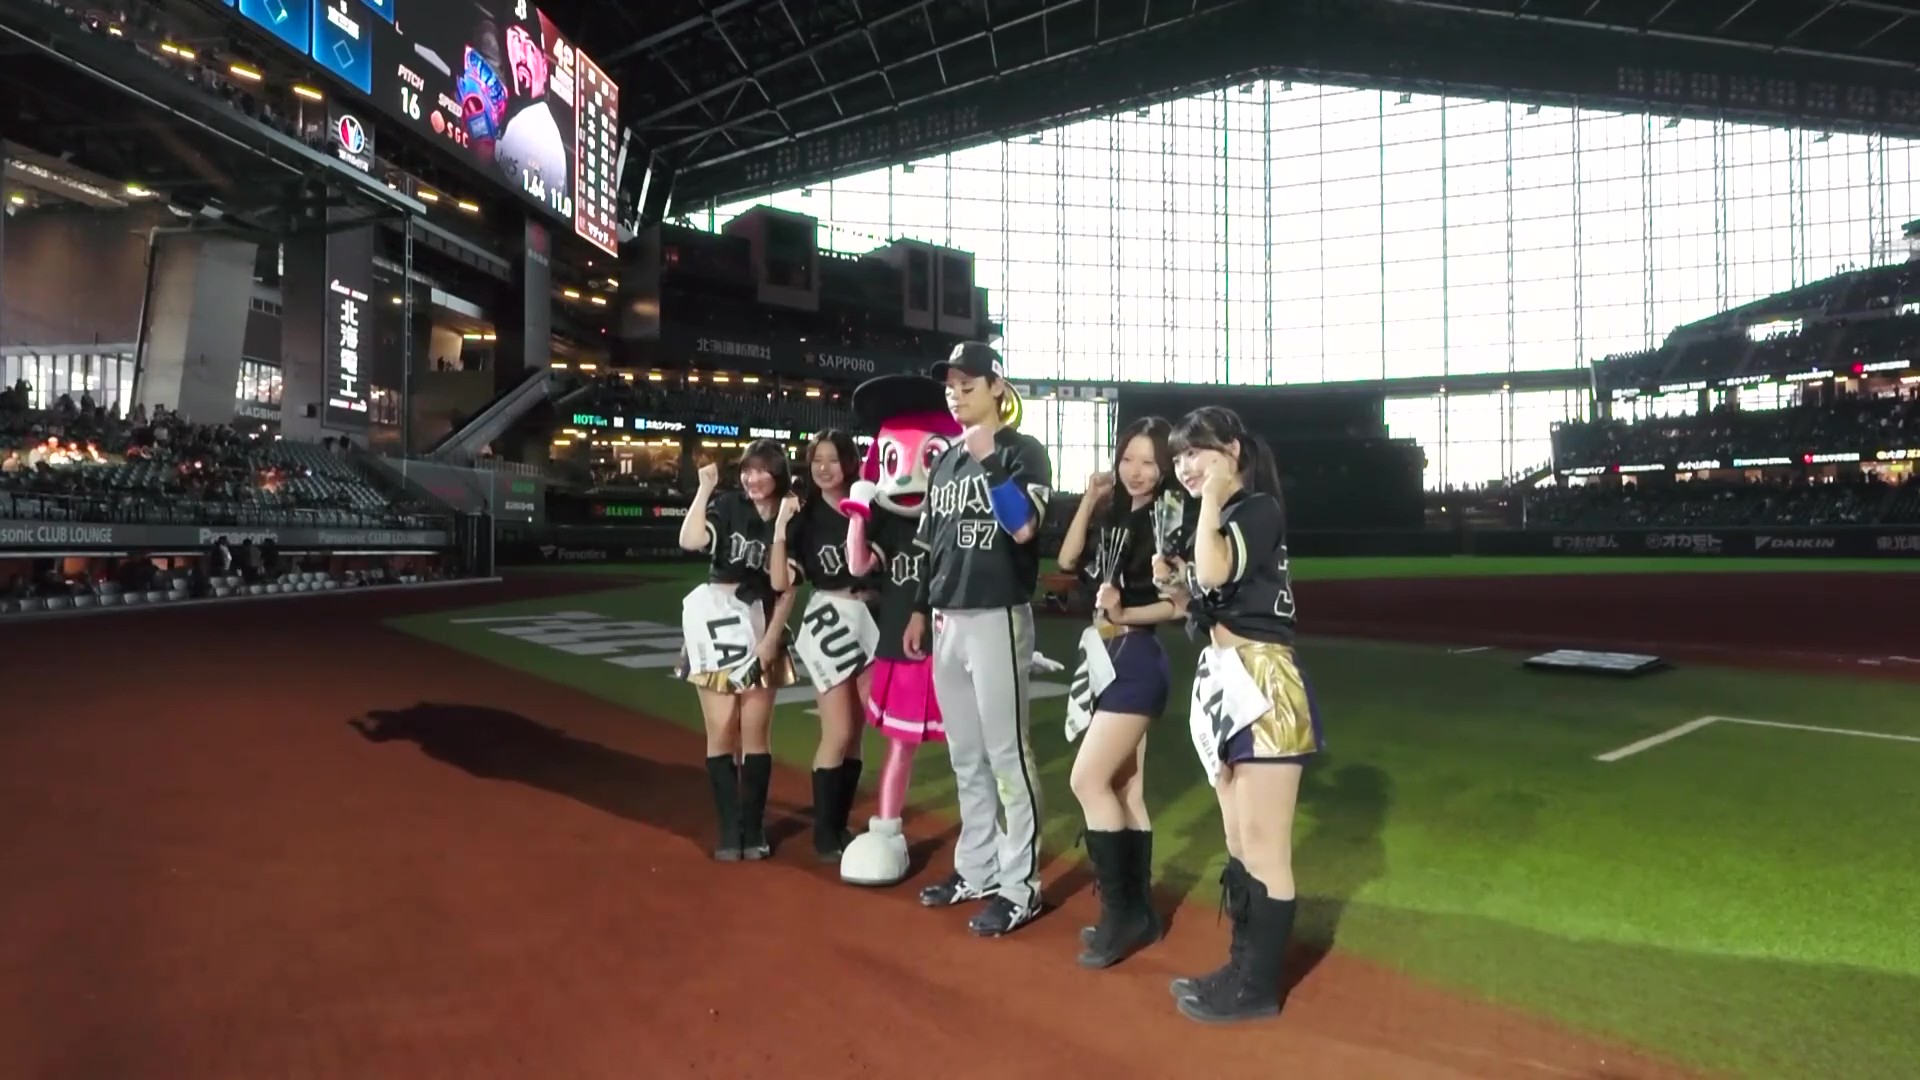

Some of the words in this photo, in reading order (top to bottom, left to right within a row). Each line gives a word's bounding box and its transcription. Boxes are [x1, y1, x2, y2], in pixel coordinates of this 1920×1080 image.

[397, 64, 425, 91] PITCH
[401, 87, 421, 120] 16
[818, 353, 875, 373] SAPPORO
[696, 423, 739, 436] TOPPAN
[37, 526, 68, 543] CLUB
[70, 527, 113, 543] LOUNGE
[1771, 537, 1835, 548] DAIKIN
